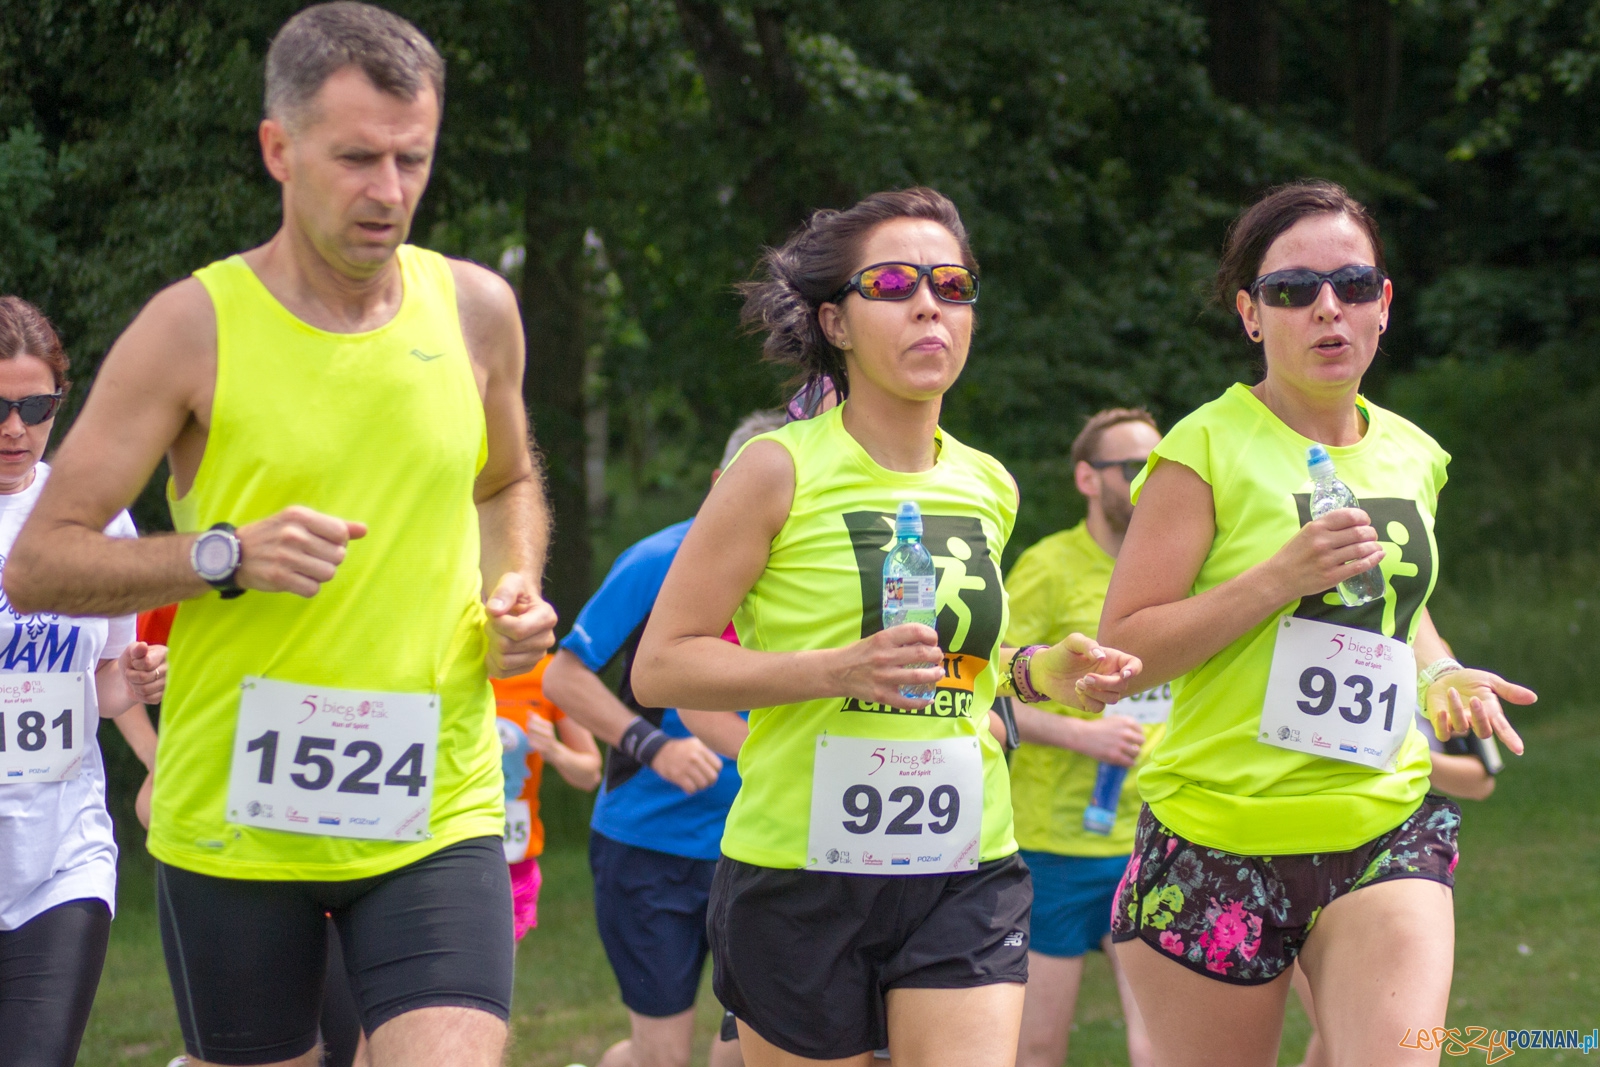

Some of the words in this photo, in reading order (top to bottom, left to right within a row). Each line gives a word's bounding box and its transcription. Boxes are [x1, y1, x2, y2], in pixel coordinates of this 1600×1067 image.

[1326, 633, 1345, 660] 5
[1347, 636, 1373, 661] bieg
[0, 684, 21, 698] ieg
[1296, 666, 1398, 732] 931
[297, 694, 318, 725] 5
[321, 697, 355, 722] bieg
[246, 729, 427, 797] 1524
[868, 747, 886, 776] 5
[890, 748, 920, 770] bieg
[932, 755, 946, 764] tak
[842, 784, 960, 835] 929
